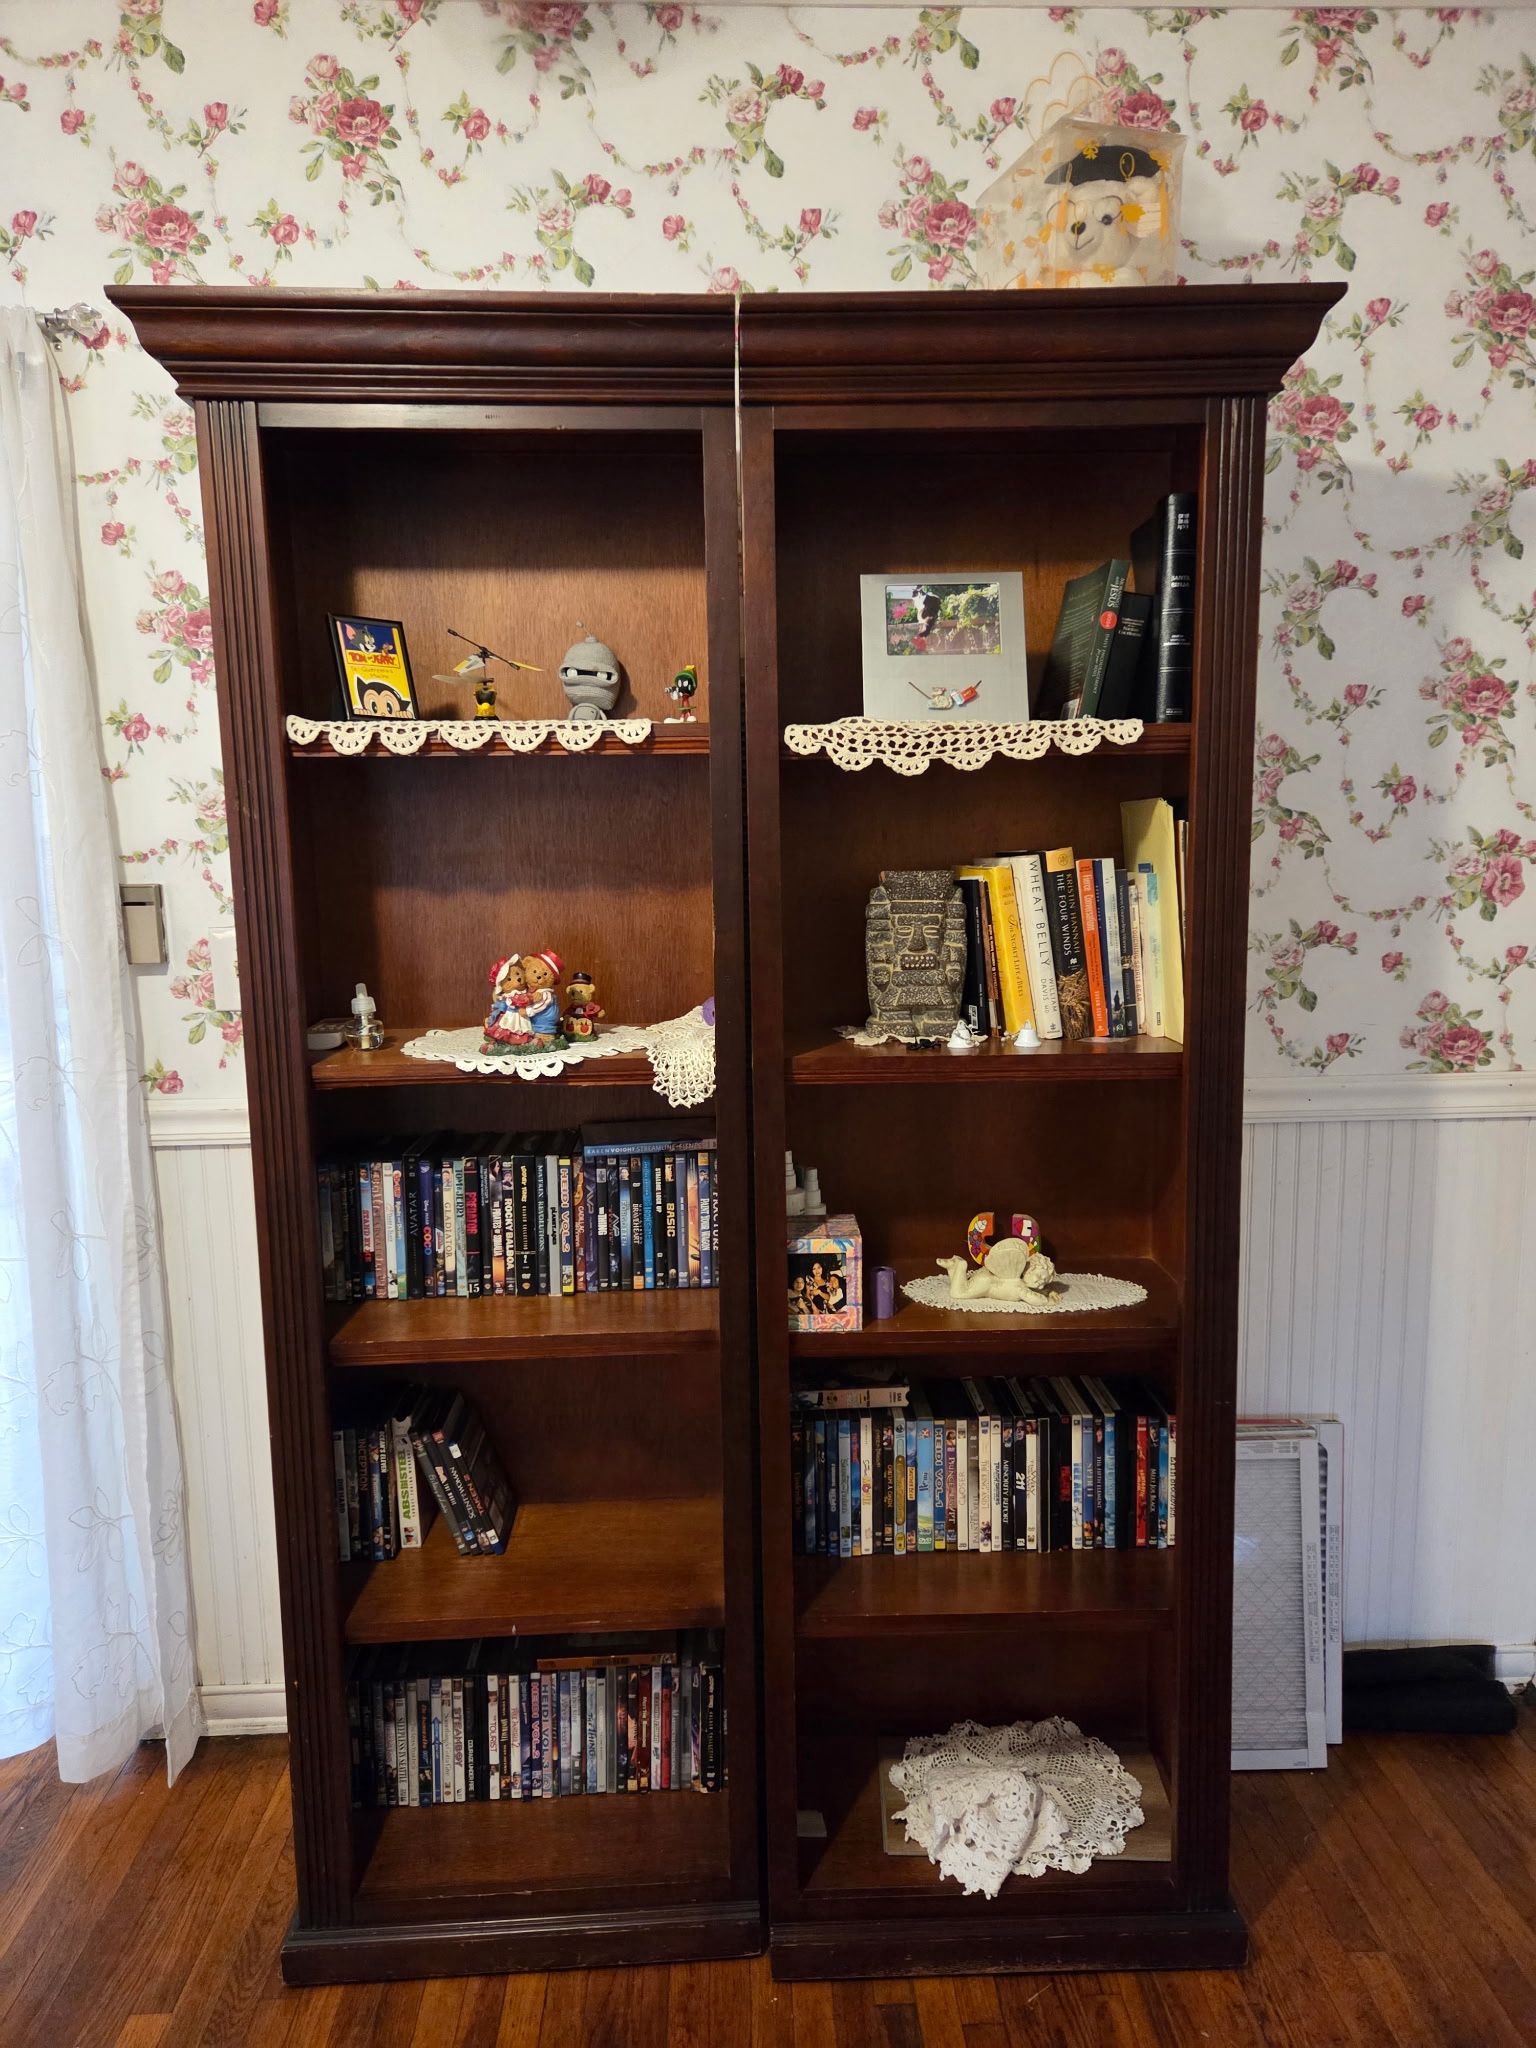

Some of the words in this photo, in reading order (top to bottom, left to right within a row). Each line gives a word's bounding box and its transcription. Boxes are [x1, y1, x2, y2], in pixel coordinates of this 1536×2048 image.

[1107, 583, 1120, 608] JESUS
[1057, 874, 1065, 891] THE
[1083, 874, 1093, 892] Fierce
[1029, 860, 1043, 914] WHEAT
[1036, 923, 1050, 967] BELLY
[1059, 895, 1068, 921] FOUR
[1065, 873, 1076, 908] KRISTIN
[1071, 912, 1081, 954] HANNAH
[1084, 894, 1096, 932] Conversations
[1062, 925, 1071, 956] WINDS
[1040, 978, 1048, 1001] DAVIS
[1048, 978, 1057, 1012] WILLIAM
[610, 1145, 635, 1153] VOIGHT
[455, 1169, 463, 1186] TOM
[537, 1165, 545, 1198] MATRIX
[560, 1168, 569, 1208] HEIDI
[409, 1192, 417, 1236] AVATAR
[456, 1191, 464, 1218] JERRY
[466, 1191, 478, 1235] PREDATOR
[586, 1185, 595, 1214] AVP
[656, 1205, 662, 1213] UP
[700, 1198, 709, 1214] PAINT
[362, 1210, 370, 1236] STAND
[492, 1208, 501, 1229] PIRATES
[504, 1198, 513, 1231] ROCKY
[598, 1214, 608, 1236] THING
[666, 1202, 675, 1237] BASIC
[701, 1215, 710, 1230] YOUR
[423, 1226, 432, 1255] COCO
[444, 1202, 452, 1258] GLADIATOR
[561, 1211, 570, 1253] VOL.2
[701, 1231, 710, 1251] WAGON
[493, 1234, 503, 1256] SOMALIA
[506, 1232, 514, 1271] BALBOA
[468, 1283, 480, 1293] 15
[379, 1431, 387, 1453] OCEAN'S
[935, 1428, 943, 1466] HEIDI
[358, 1439, 368, 1491] INCEPTION
[450, 1466, 466, 1496] WOMAN
[935, 1468, 943, 1508] VOL.1
[1015, 1472, 1025, 1490] 211
[1074, 1482, 1082, 1504] AGE
[338, 1490, 346, 1513] HARD
[402, 1488, 411, 1519] ABS
[461, 1497, 476, 1519] SCENT
[467, 1483, 486, 1516] TAKEN
[531, 1682, 539, 1718] HEIDI
[397, 1718, 406, 1752] SLEEPLESS
[454, 1707, 462, 1767] STEAMBOY
[532, 1721, 540, 1759] VOL.2
[588, 1728, 597, 1757] THING
[399, 1759, 407, 1784] SEATTLE
